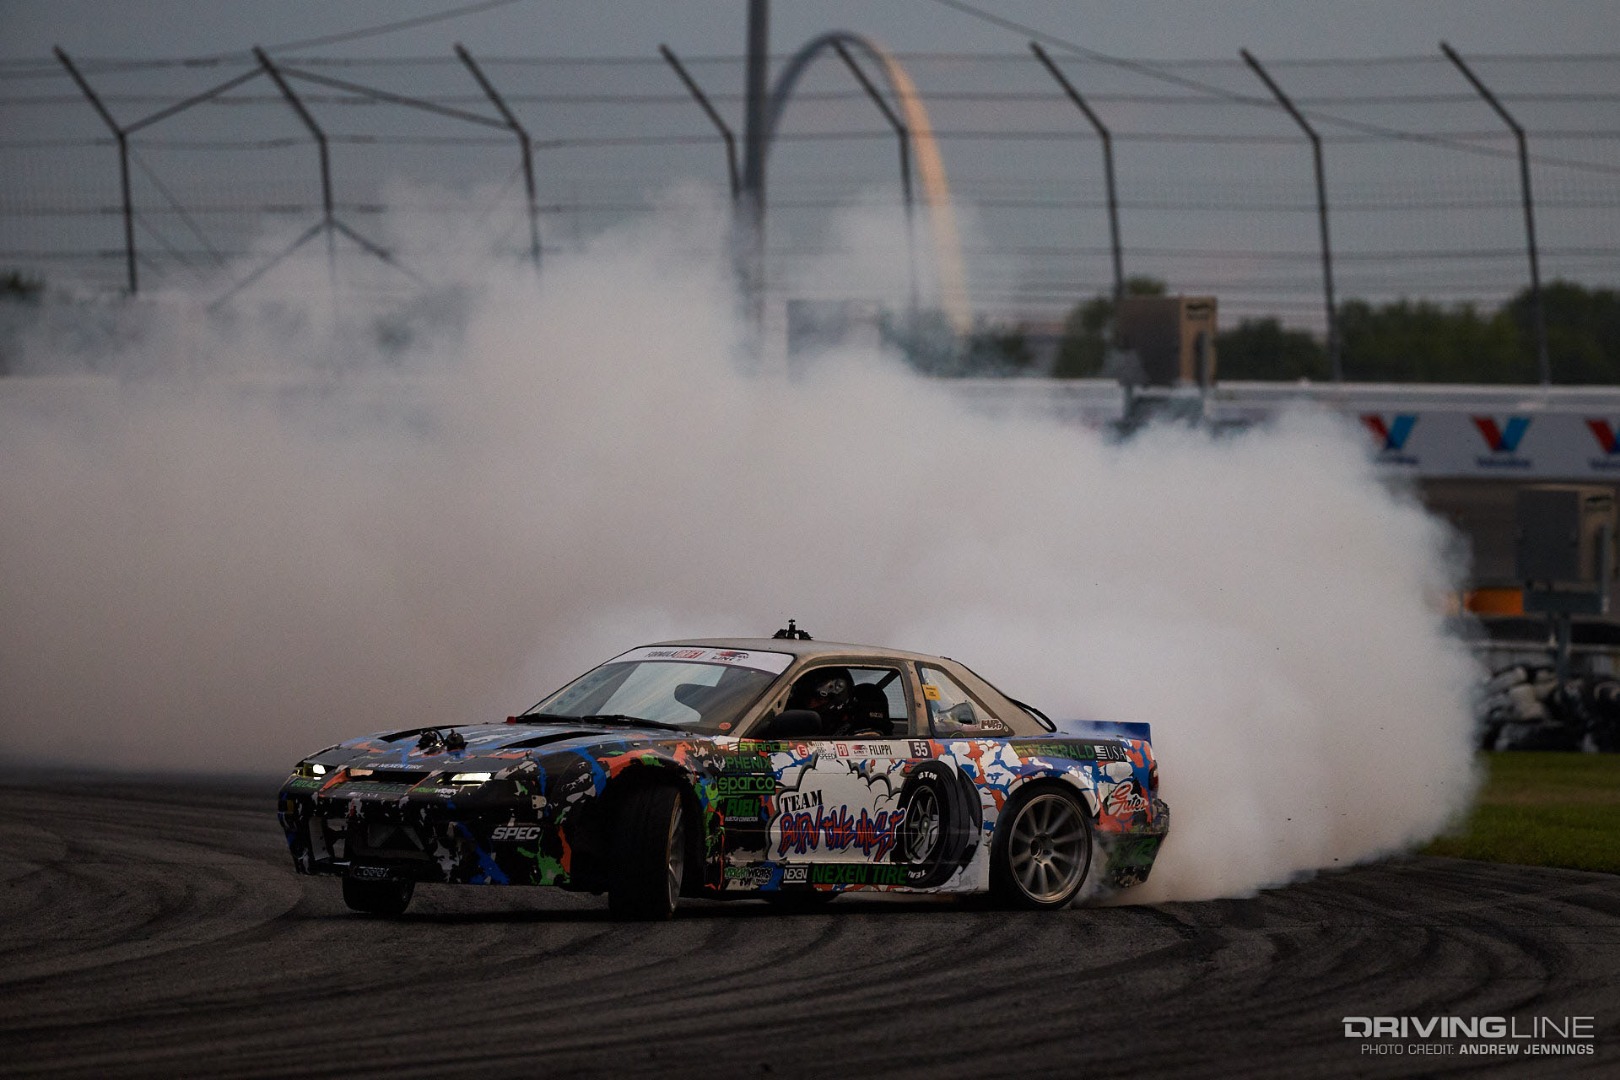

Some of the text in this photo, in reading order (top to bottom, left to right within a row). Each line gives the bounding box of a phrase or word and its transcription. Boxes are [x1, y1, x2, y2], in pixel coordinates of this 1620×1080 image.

[739, 742, 788, 752] STANCE
[868, 744, 893, 756] FILIPPI
[912, 742, 929, 757] 55
[1013, 744, 1127, 760] FITZGERALD USA
[725, 755, 771, 769] PHENIX
[718, 776, 775, 794] sparco
[780, 790, 823, 813] TEAM
[490, 826, 541, 840] SPEC
[811, 864, 907, 884] NEXEN TIRE
